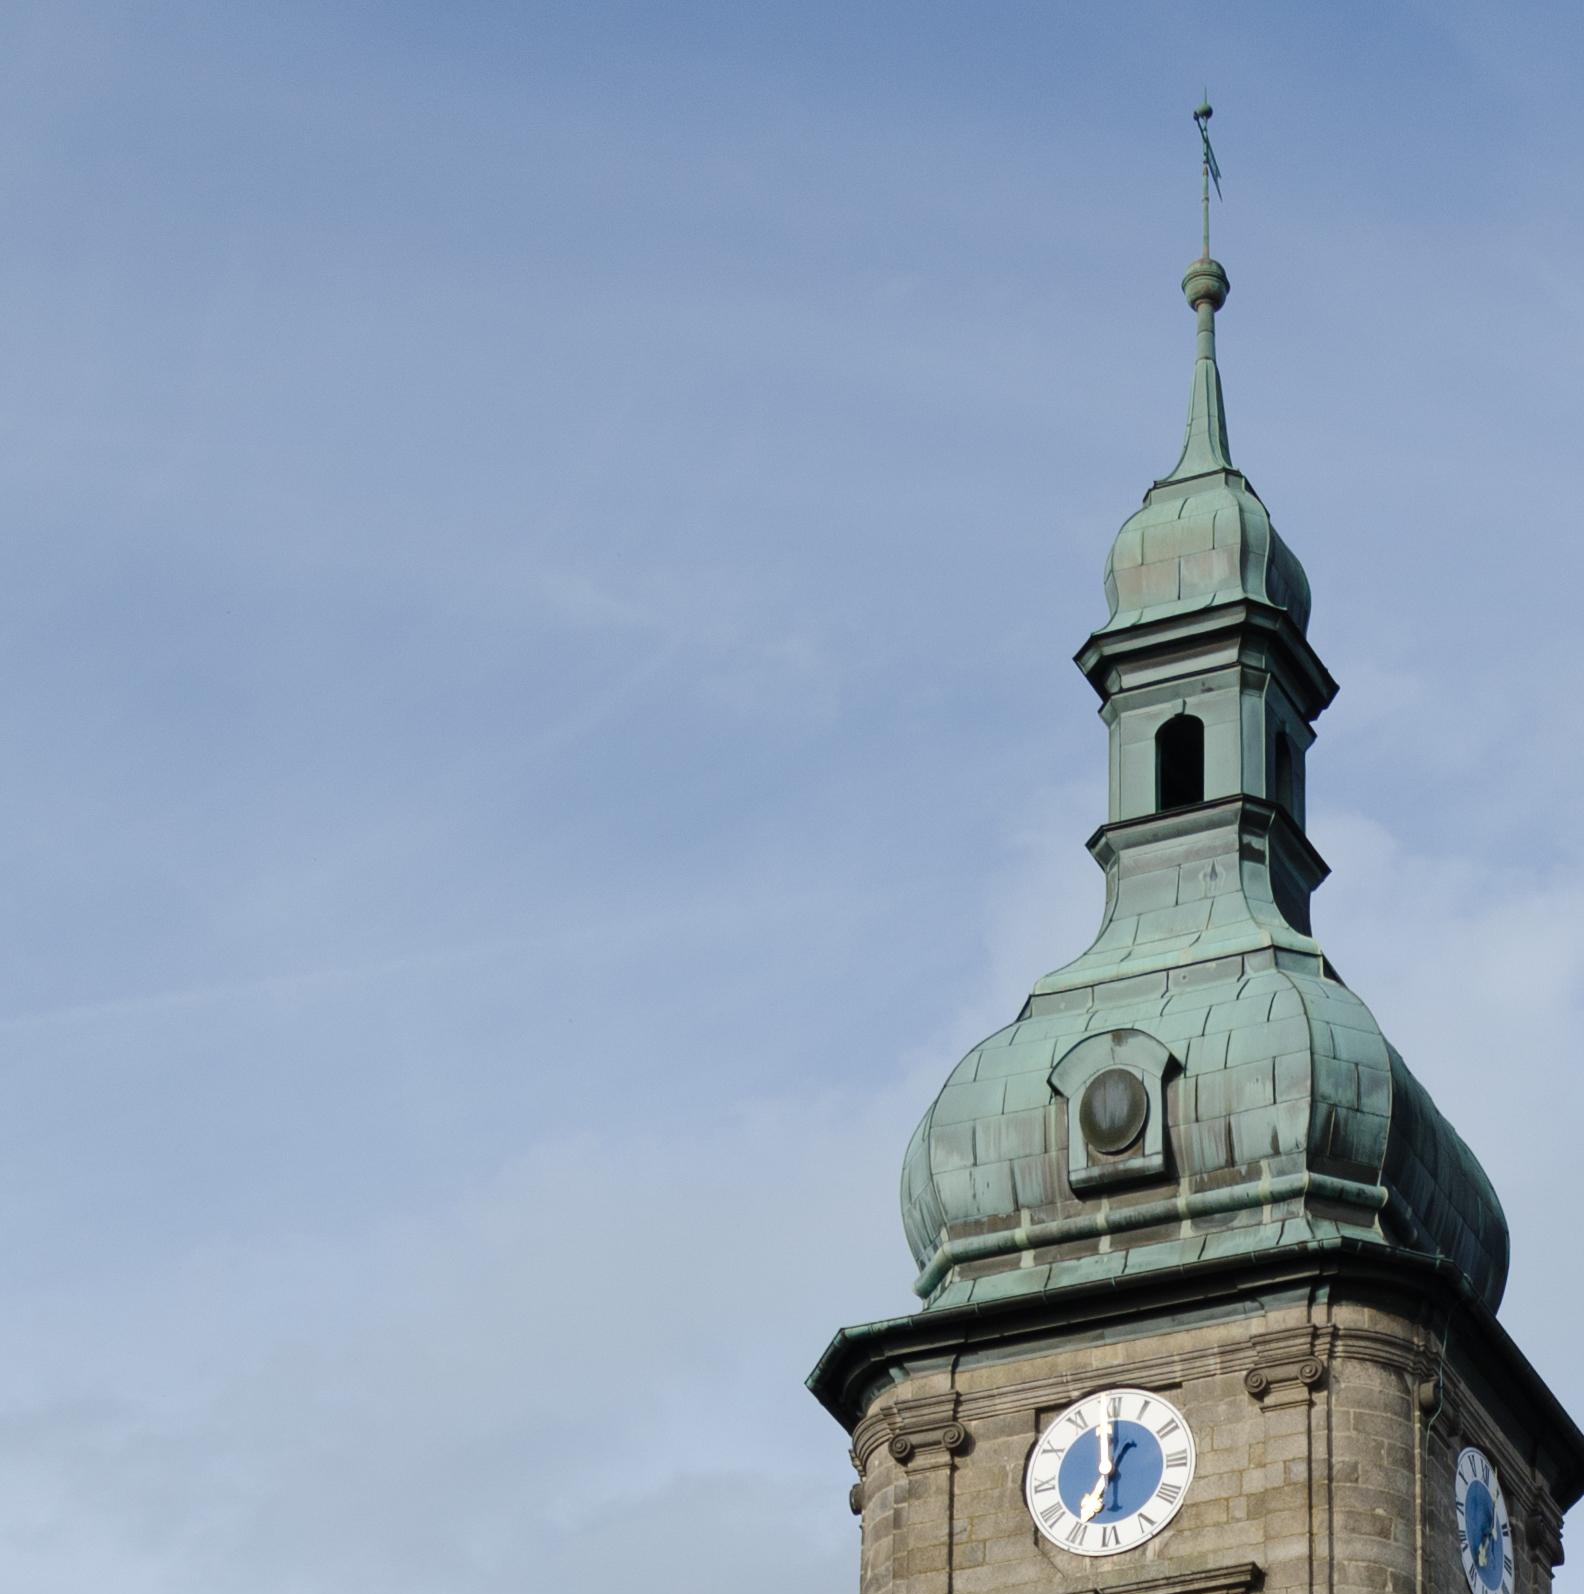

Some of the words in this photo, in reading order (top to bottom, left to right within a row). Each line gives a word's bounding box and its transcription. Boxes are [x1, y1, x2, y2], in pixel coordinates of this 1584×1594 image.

[1042, 1440, 1065, 1460] X
[1166, 1448, 1188, 1468] III
[1040, 1502, 1066, 1528] VIII
[1065, 1522, 1088, 1546] VII
[1100, 1525, 1121, 1547] VI
